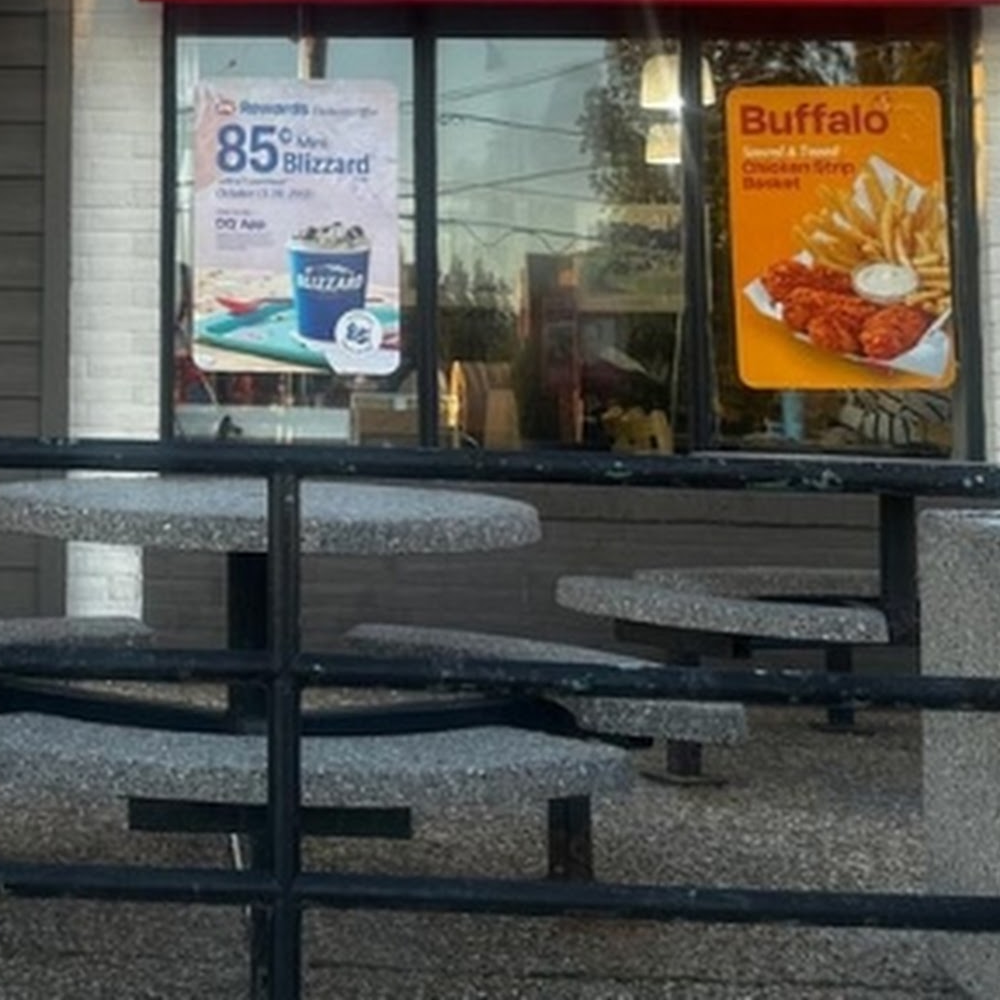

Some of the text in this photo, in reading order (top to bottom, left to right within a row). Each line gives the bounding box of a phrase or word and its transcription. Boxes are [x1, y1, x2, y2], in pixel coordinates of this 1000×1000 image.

[739, 103, 889, 135] Buffalo
[283, 151, 370, 174] Blizzard
[742, 160, 856, 176] Chicken Strip
[743, 177, 800, 190] Basket
[241, 219, 267, 231] App
